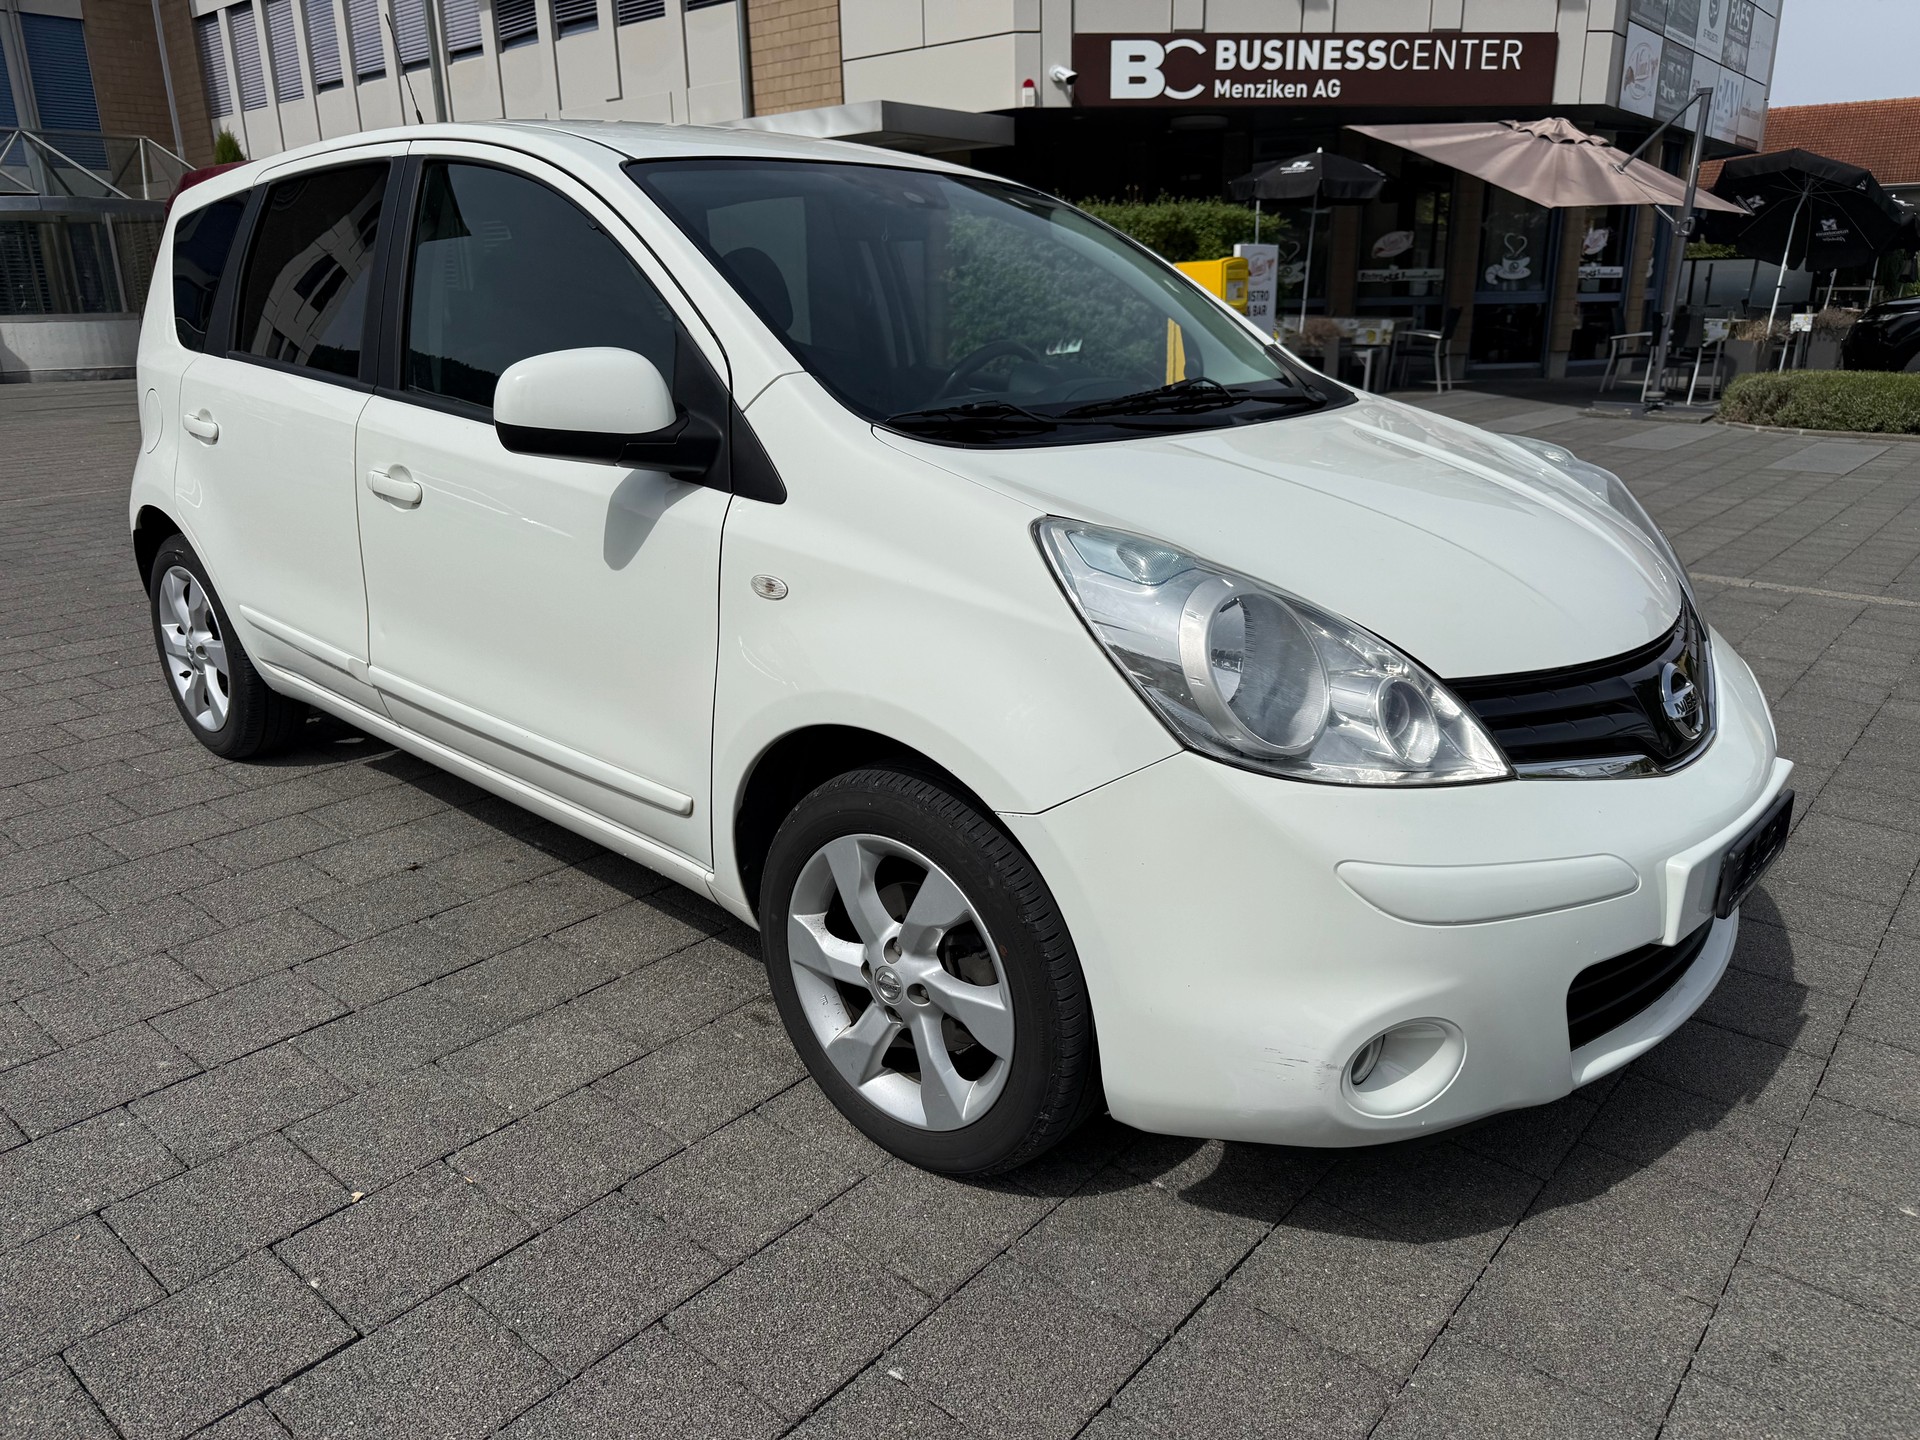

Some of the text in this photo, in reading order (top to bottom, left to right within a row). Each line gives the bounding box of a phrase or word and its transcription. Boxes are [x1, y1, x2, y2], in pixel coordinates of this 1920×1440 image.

[1215, 39, 1523, 71] BUSINESSCENTER
[1110, 38, 1207, 100] BC
[1214, 78, 1341, 99] Menziken AG
[1247, 290, 1270, 302] ISTRO
[1252, 304, 1268, 317] BAR
